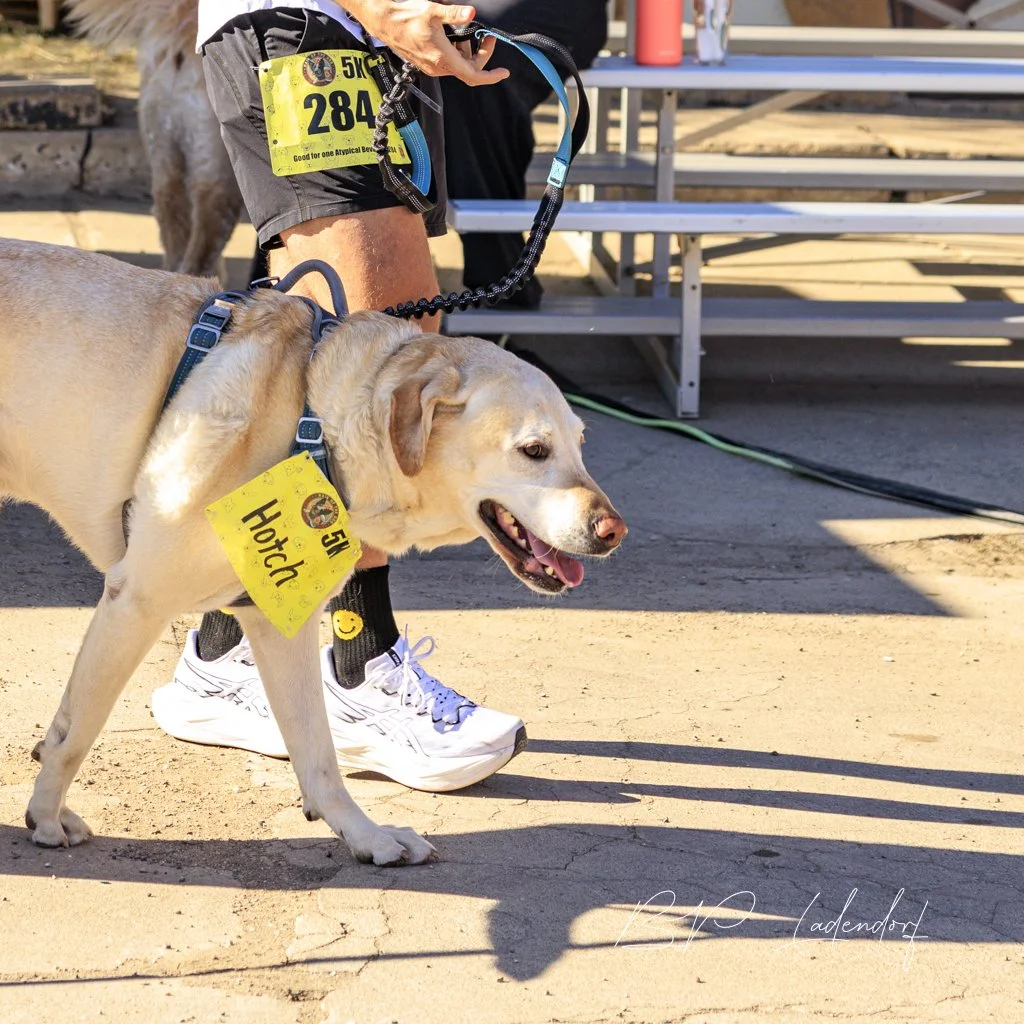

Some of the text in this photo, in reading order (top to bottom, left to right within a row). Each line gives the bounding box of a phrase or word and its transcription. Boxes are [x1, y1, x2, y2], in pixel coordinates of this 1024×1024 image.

[340, 56, 368, 80] 5K
[303, 90, 377, 136] 284
[293, 154, 310, 163] Good
[311, 151, 321, 160] for
[322, 149, 334, 158] one
[335, 145, 361, 156] Atypical
[240, 498, 305, 588] Hotch
[320, 528, 351, 560] 5K
